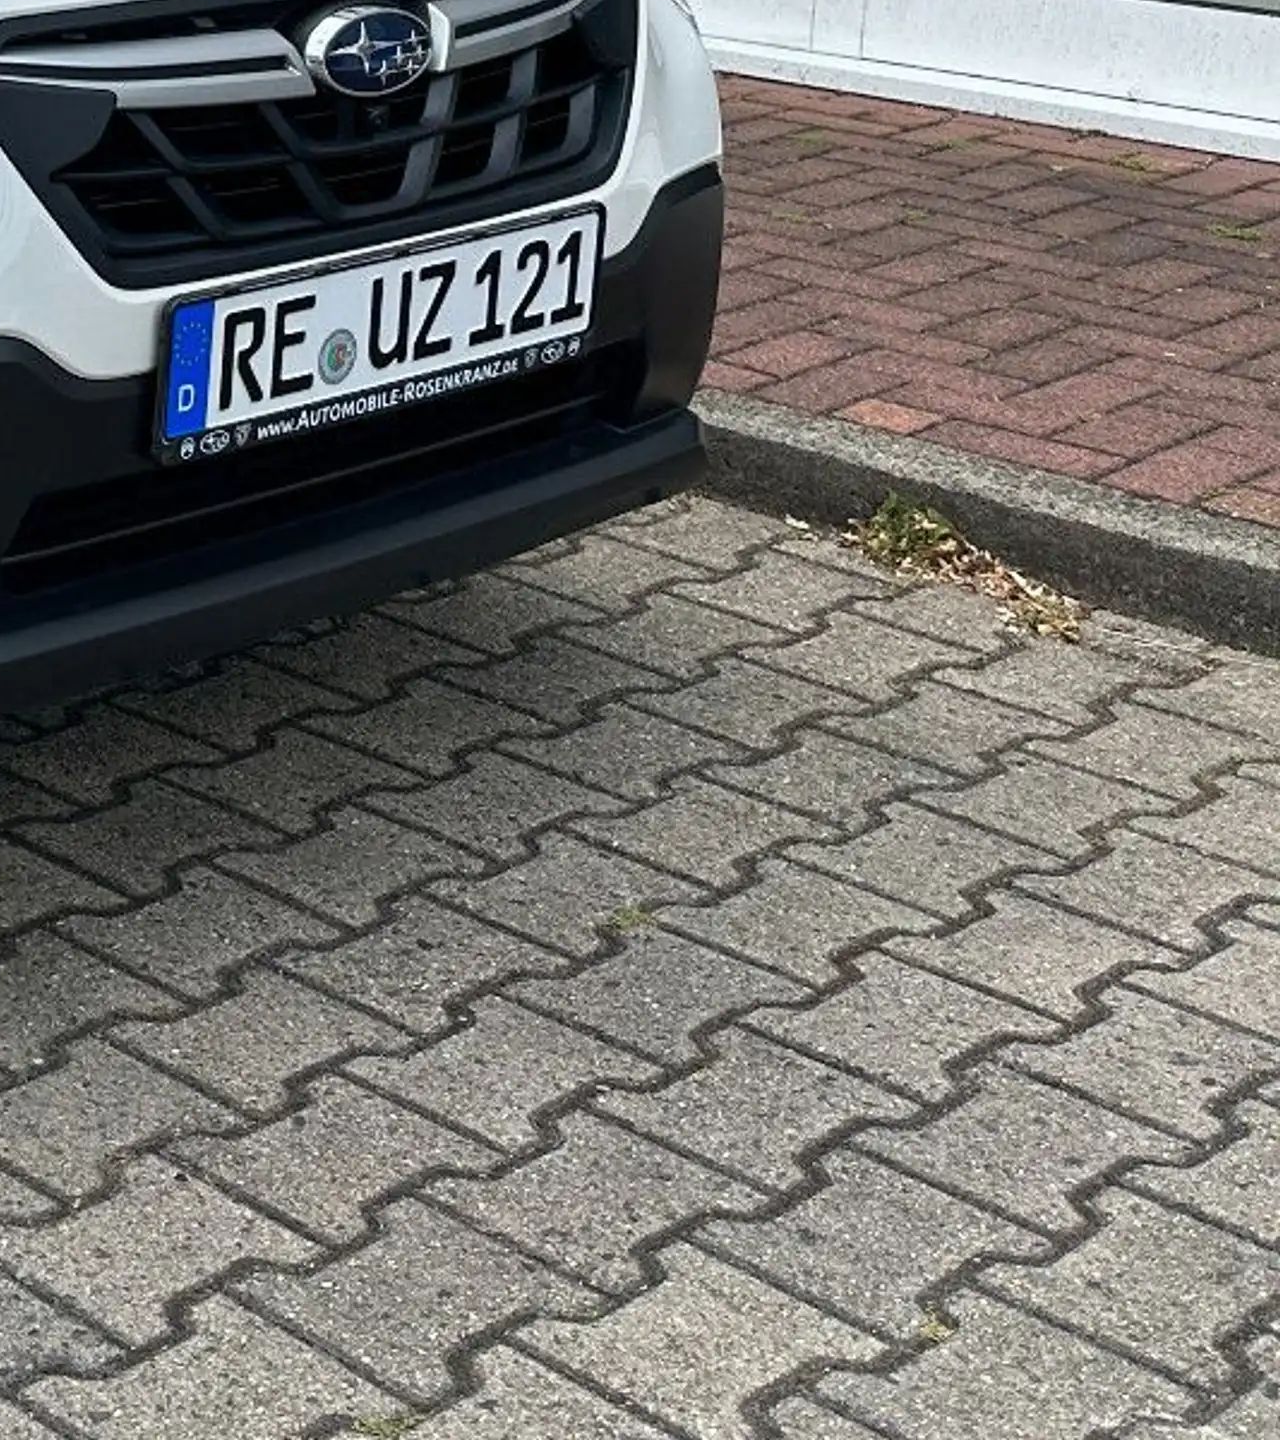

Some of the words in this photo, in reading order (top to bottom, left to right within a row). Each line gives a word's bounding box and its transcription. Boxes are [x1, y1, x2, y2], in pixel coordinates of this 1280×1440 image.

[177, 383, 195, 412] D
[218, 294, 317, 411] RE
[367, 259, 458, 370] UZ
[468, 229, 586, 348] 121
